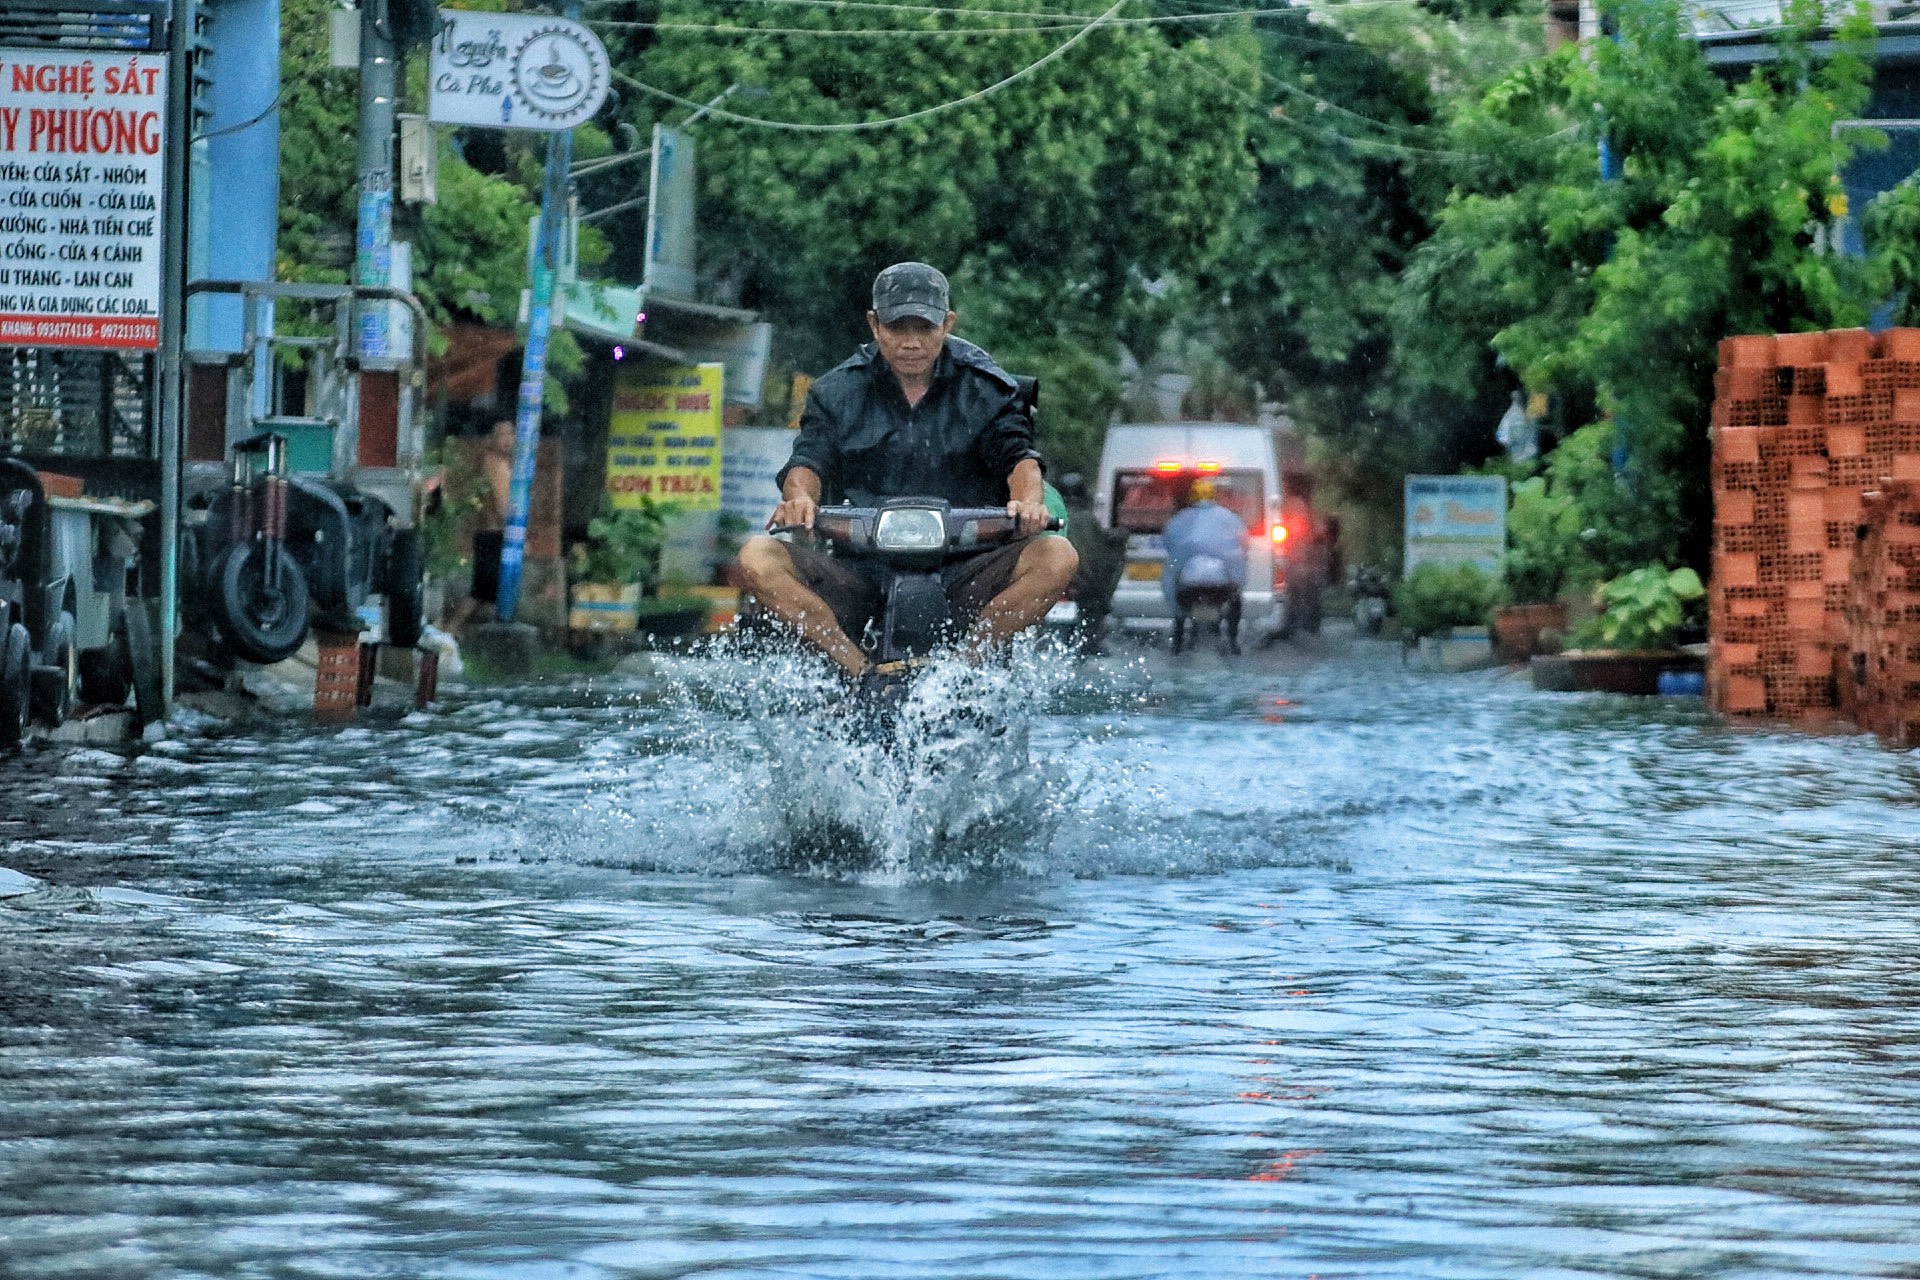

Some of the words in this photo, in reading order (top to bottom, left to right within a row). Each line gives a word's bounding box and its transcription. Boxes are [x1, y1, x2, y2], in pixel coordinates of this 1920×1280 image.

[12, 60, 95, 100] NGHỆ
[105, 57, 160, 95] SẮT
[29, 107, 160, 154] PHƯƠNG
[34, 161, 61, 182] CỬA
[103, 165, 147, 184] NHÔM
[10, 186, 37, 207] CỬA
[42, 187, 82, 208] CUỐN
[99, 188, 126, 210] CỬA
[127, 216, 155, 237] CHẾ
[59, 240, 86, 261] CỬA
[90, 245, 100, 261] 4
[104, 243, 142, 262] CÁNH
[13, 270, 61, 286] THANG
[75, 271, 101, 287] LAN
[104, 272, 133, 288] CAN
[38, 296, 58, 312] GIA
[61, 296, 93, 317] DỤNG
[97, 294, 119, 313] CÁC
